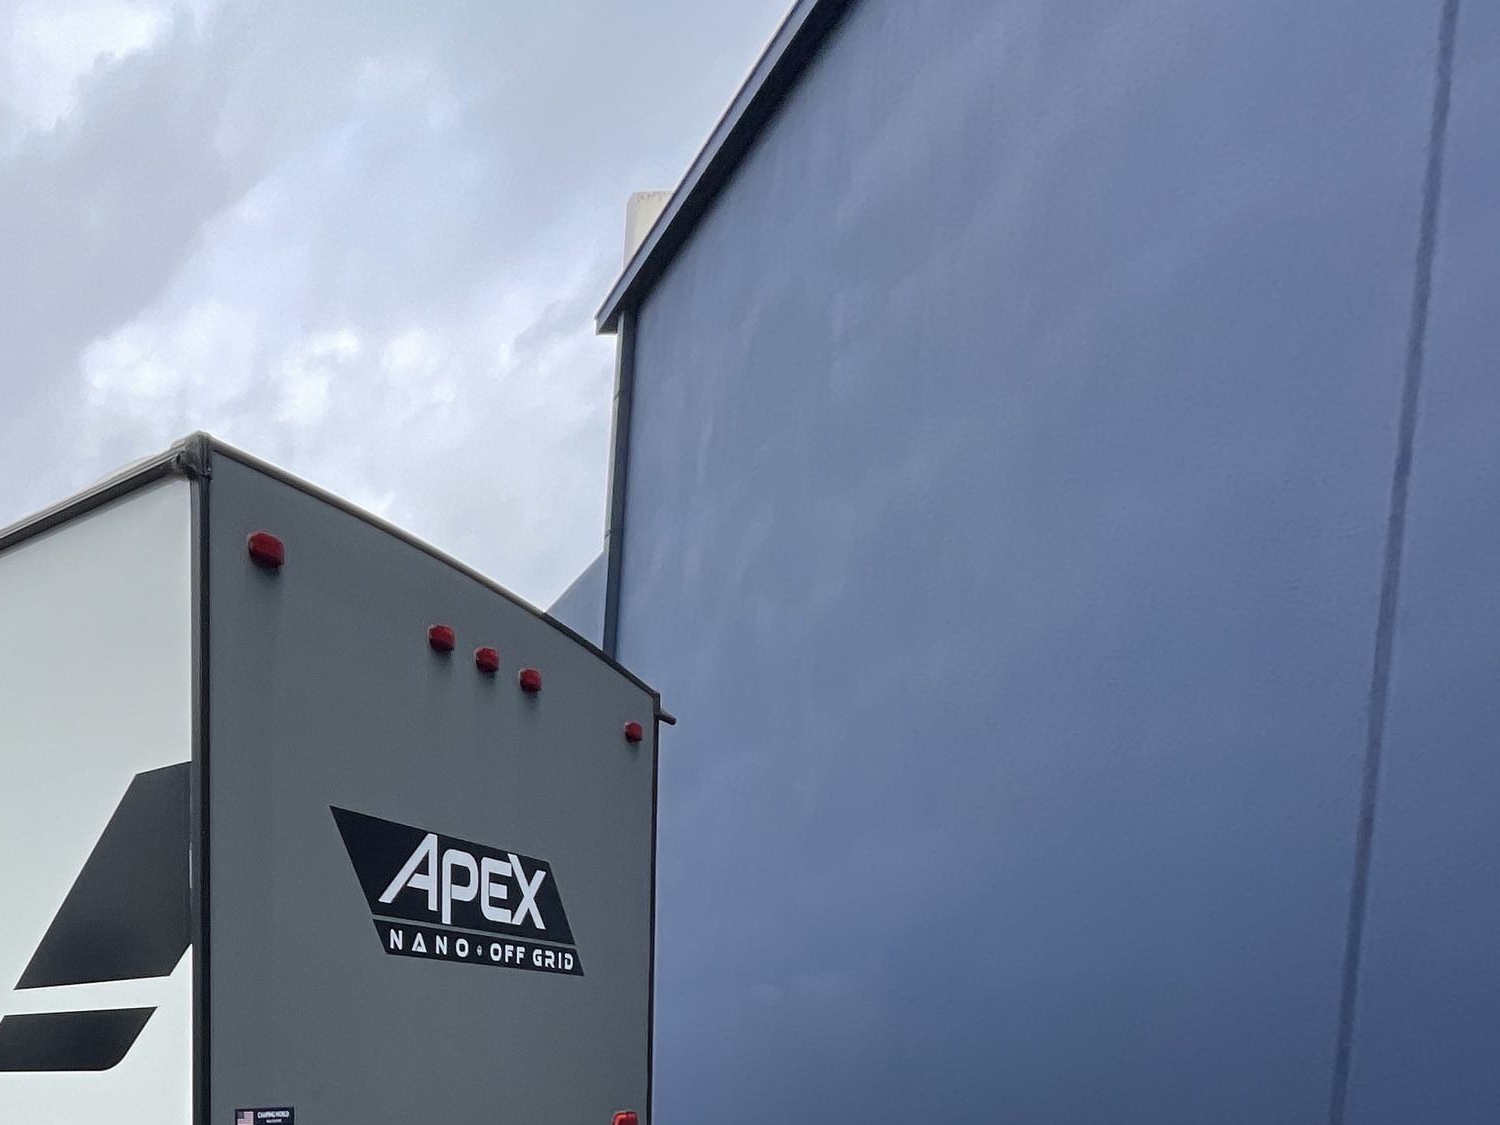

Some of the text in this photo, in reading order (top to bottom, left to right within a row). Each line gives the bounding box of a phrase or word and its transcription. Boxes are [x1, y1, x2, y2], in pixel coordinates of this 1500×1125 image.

[378, 832, 547, 930] APEX
[389, 928, 574, 971] NANO OFF GRID
